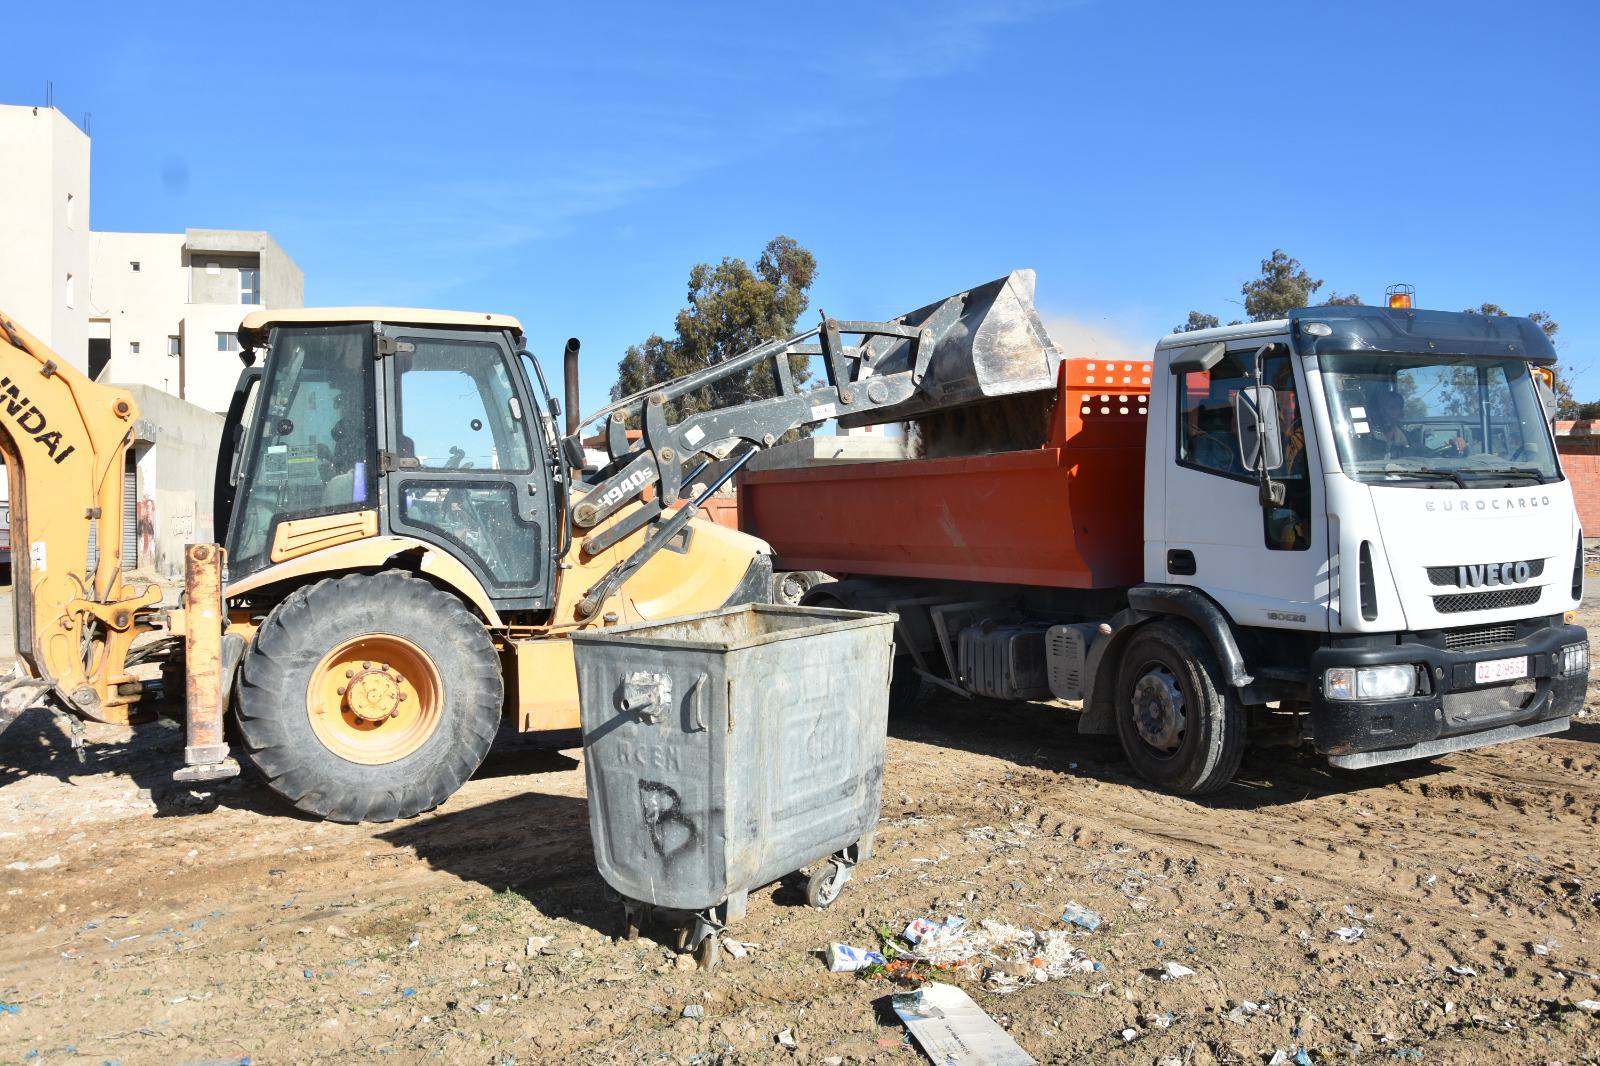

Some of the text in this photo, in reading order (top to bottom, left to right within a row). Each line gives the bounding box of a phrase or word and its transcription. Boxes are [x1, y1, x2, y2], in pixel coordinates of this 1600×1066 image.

[0, 376, 75, 464] NDAI
[1425, 496, 1551, 512] EUROCARGO
[1457, 561, 1531, 588] IVECO
